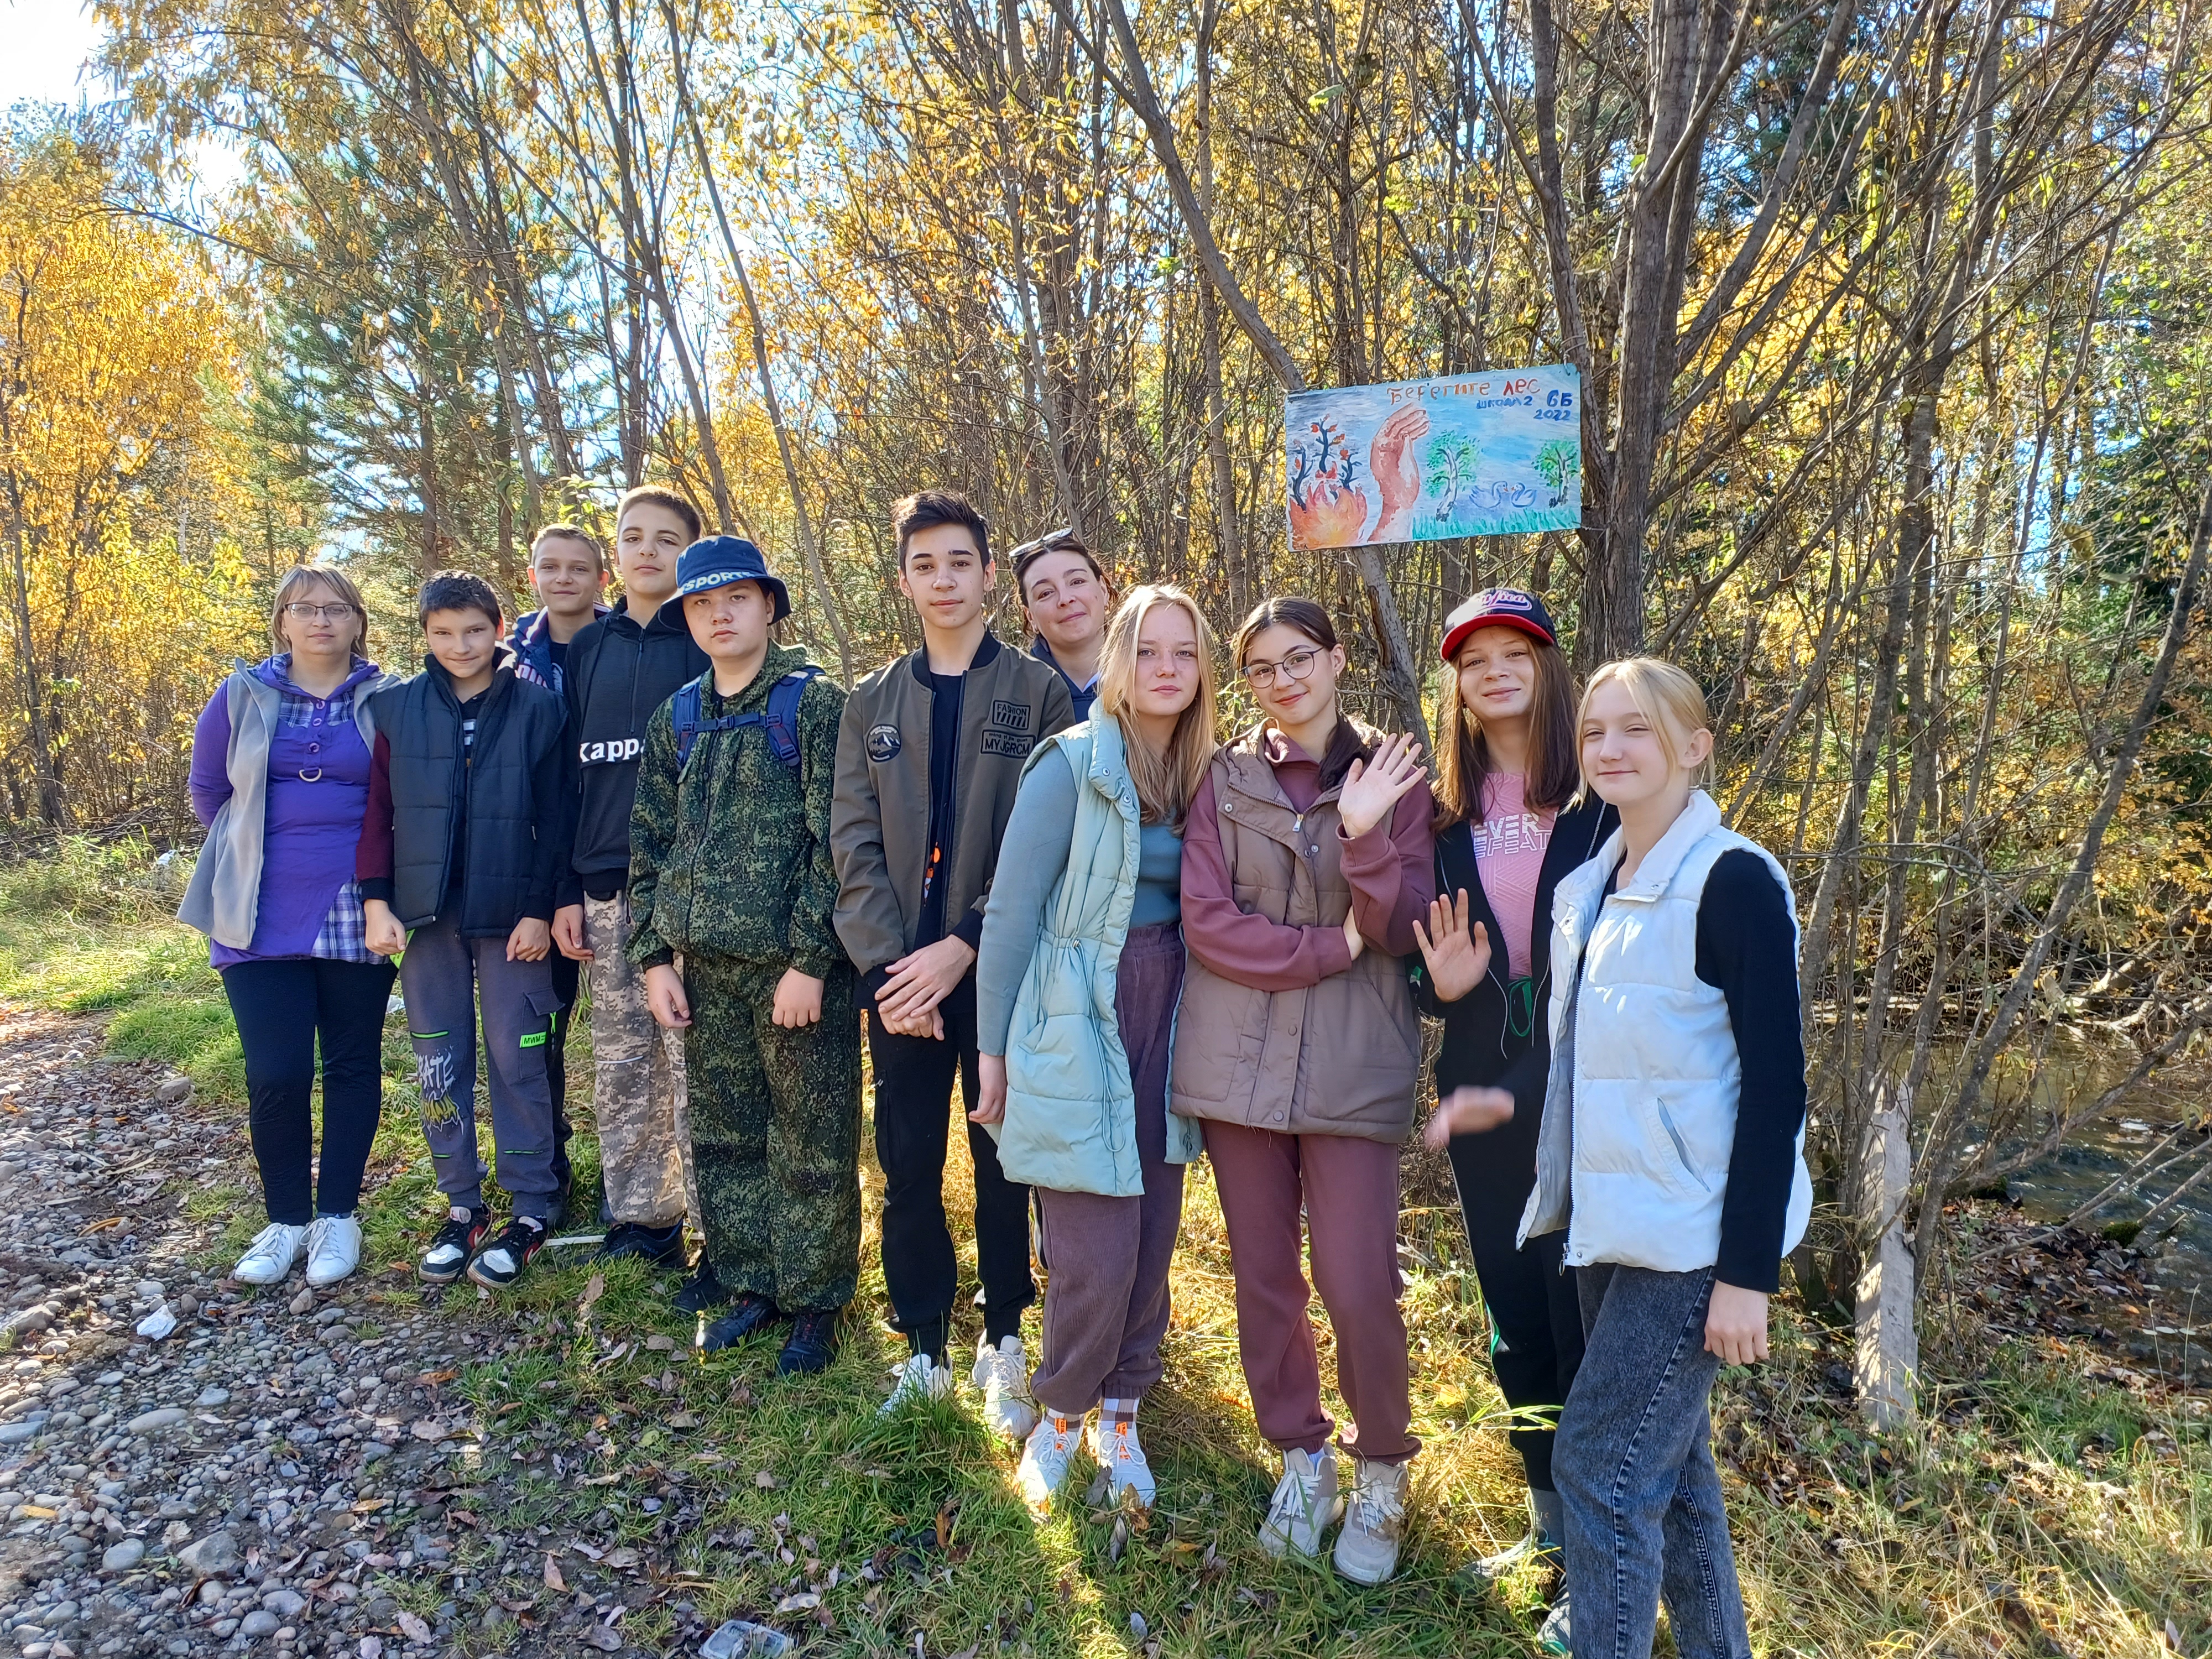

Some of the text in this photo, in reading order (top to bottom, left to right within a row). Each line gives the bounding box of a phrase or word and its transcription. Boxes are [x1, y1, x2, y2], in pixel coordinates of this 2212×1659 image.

[1533, 409, 1572, 421] 2022
[684, 571, 755, 591] SPORTS
[997, 703, 1027, 716] FASHION
[580, 738, 646, 763] Kapp
[1470, 812, 1540, 842] EVER
[1474, 830, 1552, 859] EFEAT
